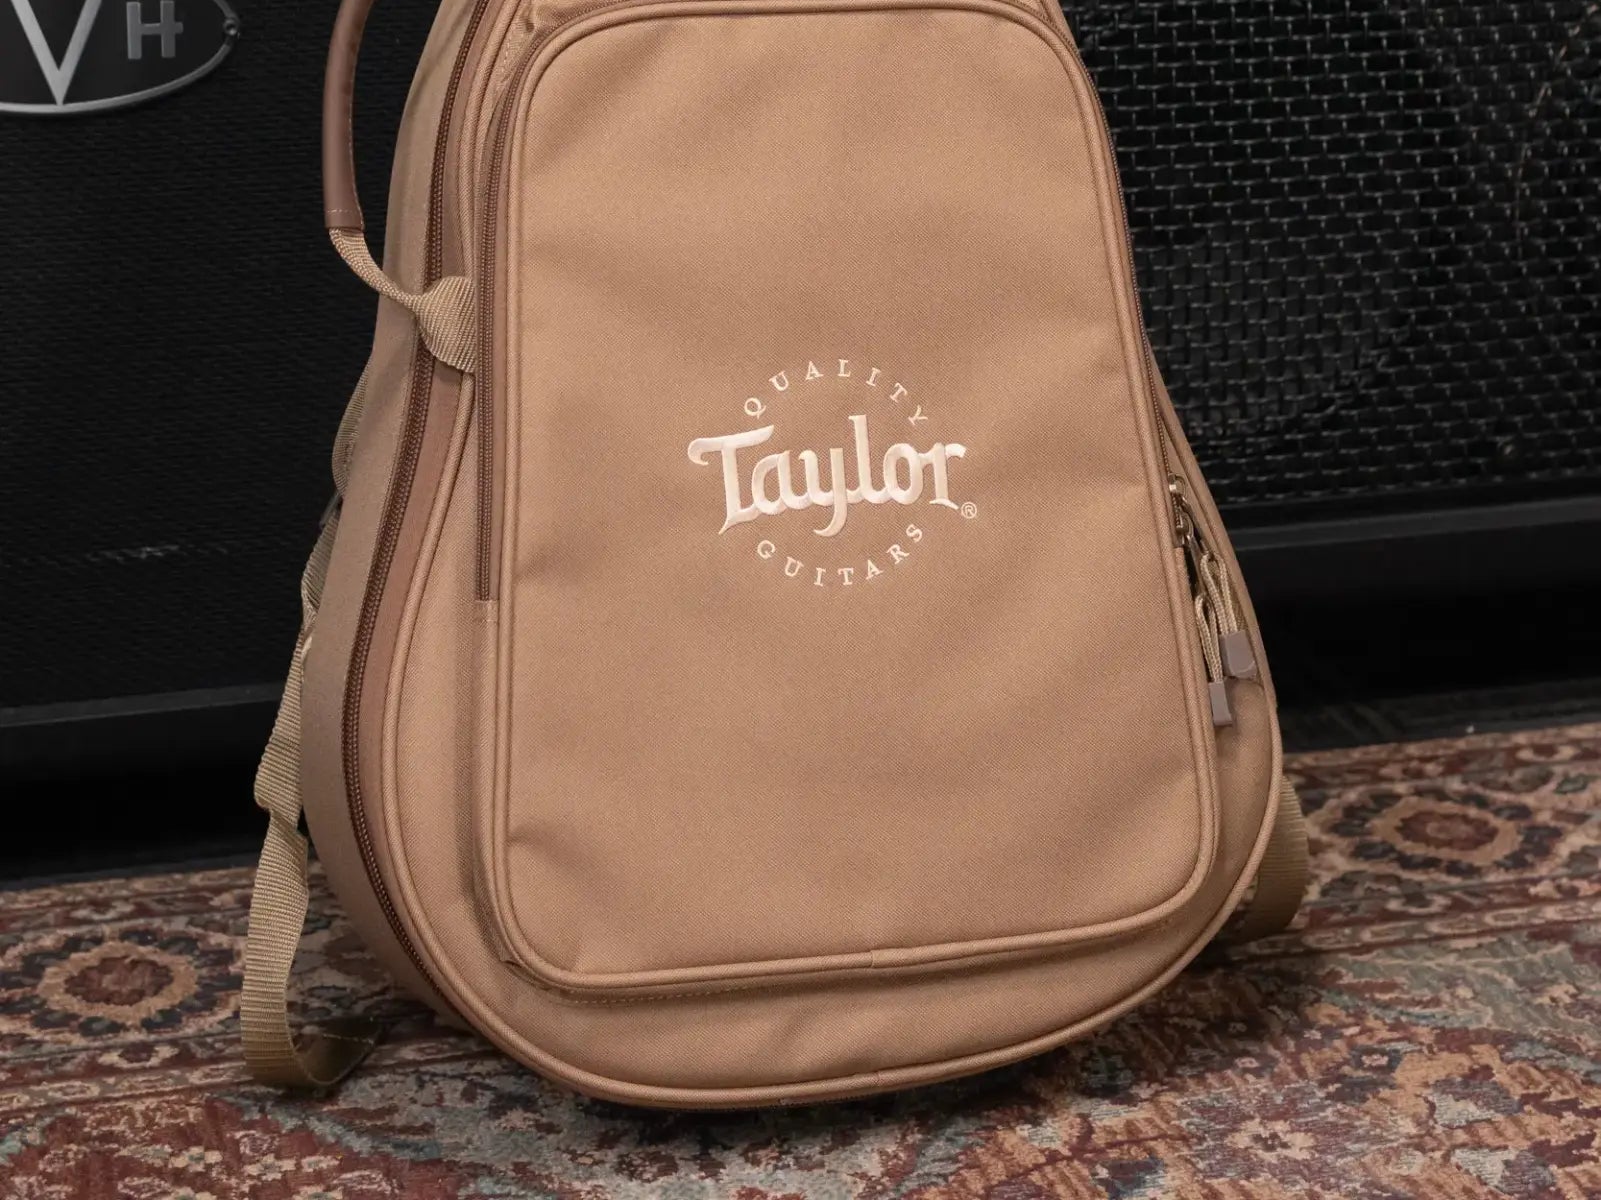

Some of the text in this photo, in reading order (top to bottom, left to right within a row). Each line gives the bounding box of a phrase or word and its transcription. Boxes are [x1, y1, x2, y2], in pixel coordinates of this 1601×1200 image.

[744, 358, 928, 425] QUALITY
[687, 414, 967, 537] Taylor
[757, 523, 924, 587] GUITARS
